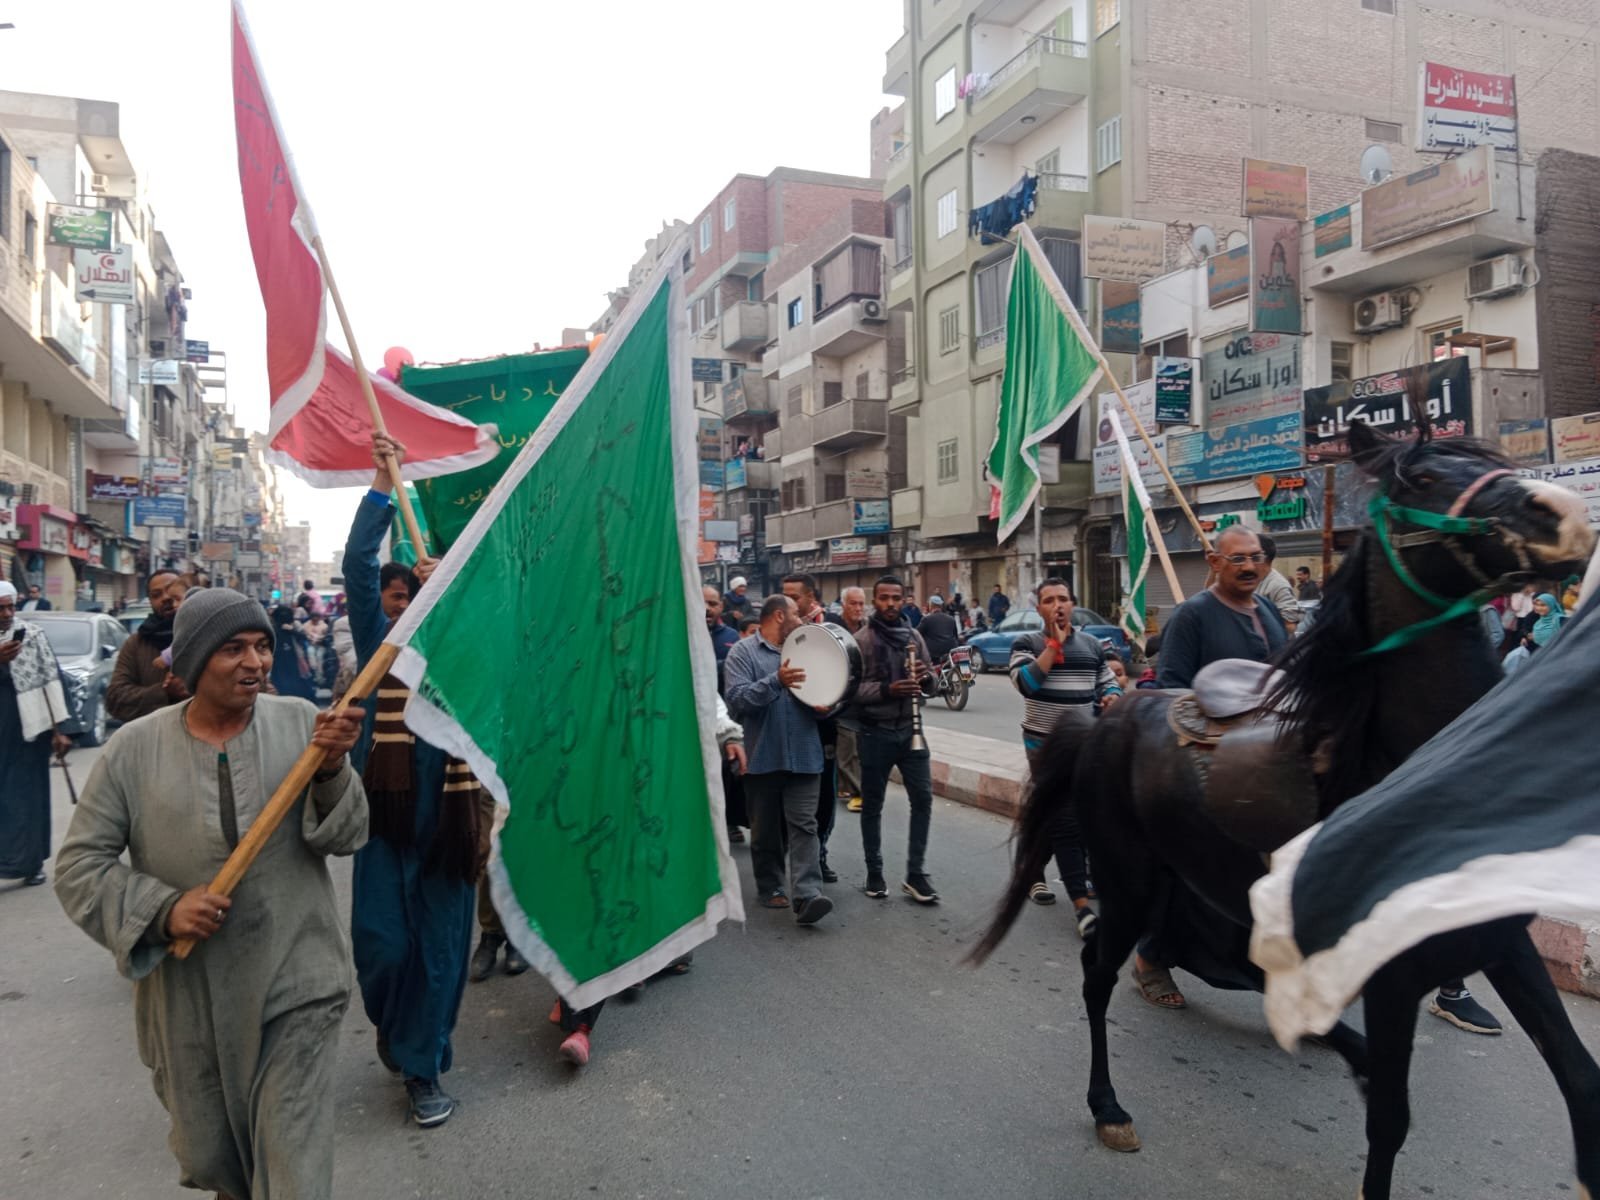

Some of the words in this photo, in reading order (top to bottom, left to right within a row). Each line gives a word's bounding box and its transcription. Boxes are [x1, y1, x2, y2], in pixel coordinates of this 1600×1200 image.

[79, 265, 131, 284] الهلال
[1259, 274, 1296, 292] كوين
[1210, 367, 1261, 401] سكان
[1402, 378, 1452, 423] أوا
[1271, 429, 1300, 444] محمد
